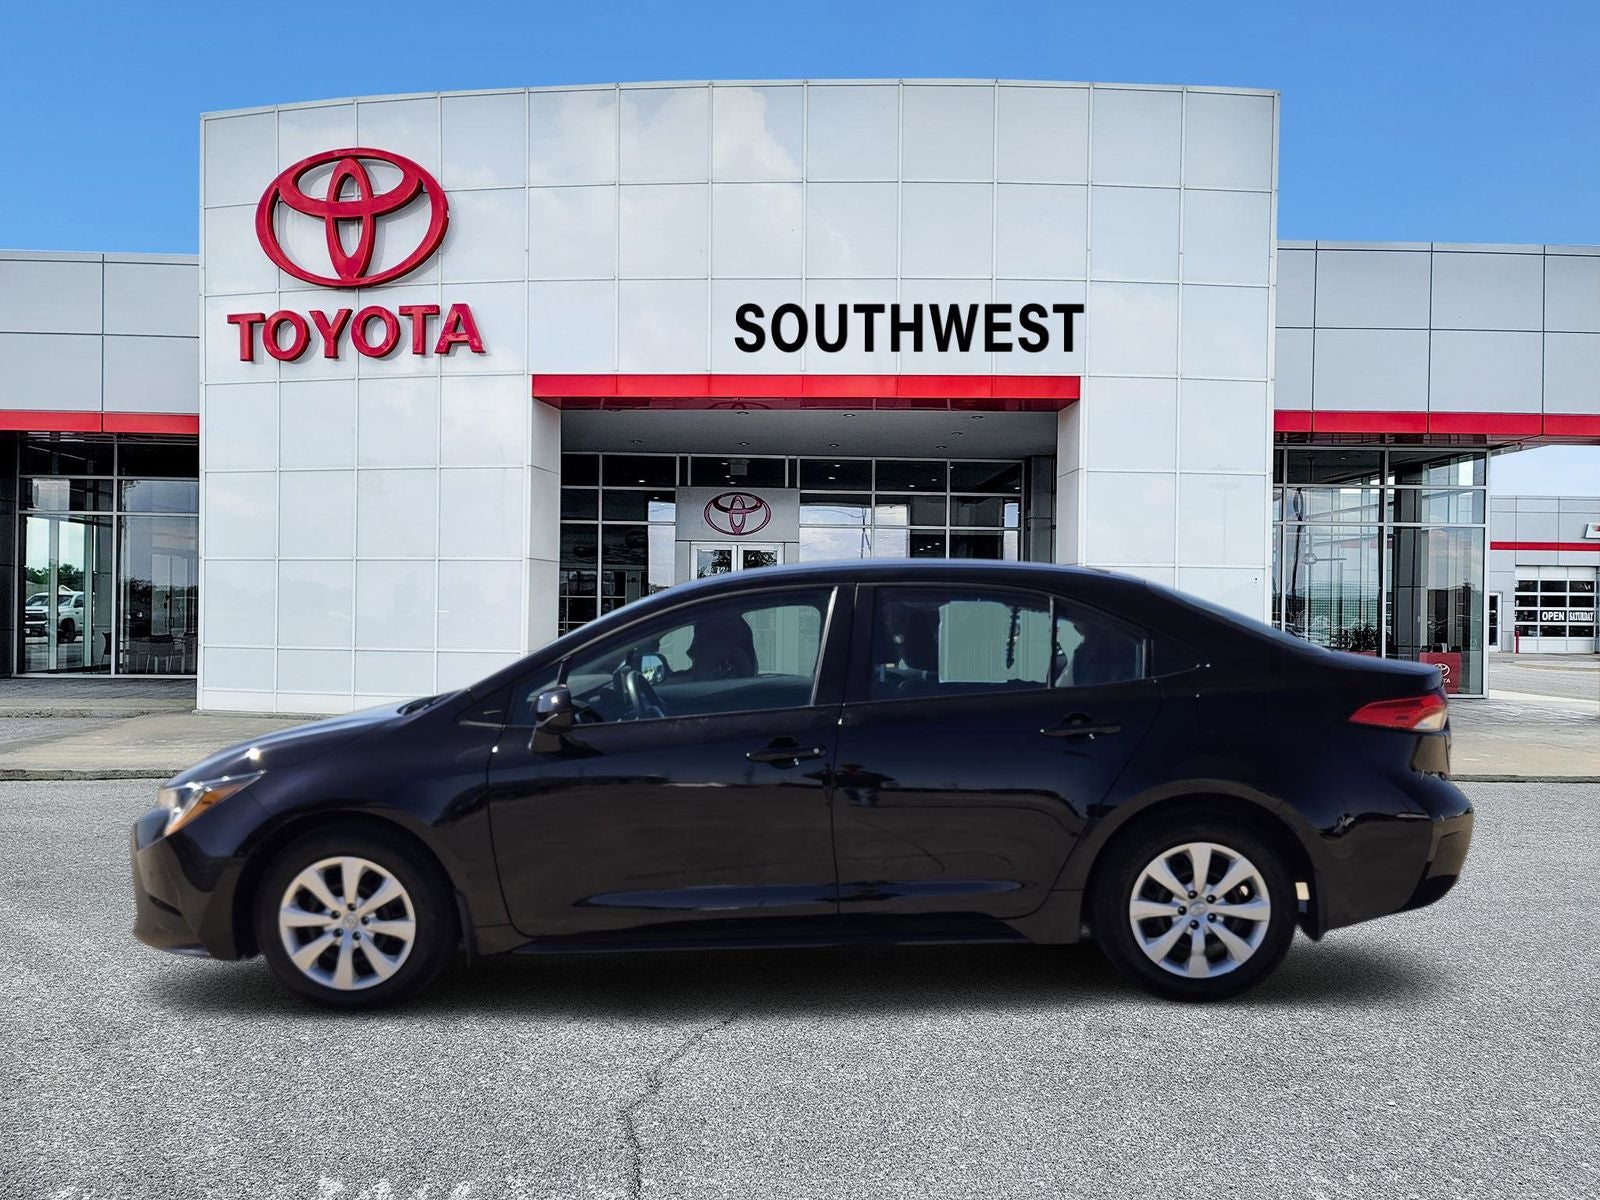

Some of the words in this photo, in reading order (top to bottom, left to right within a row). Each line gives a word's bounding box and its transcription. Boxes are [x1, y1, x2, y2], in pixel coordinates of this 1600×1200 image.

[226, 303, 486, 362] TOYOTA
[734, 303, 1085, 353] SOUTHWEST
[1541, 611, 1565, 621] OPEN
